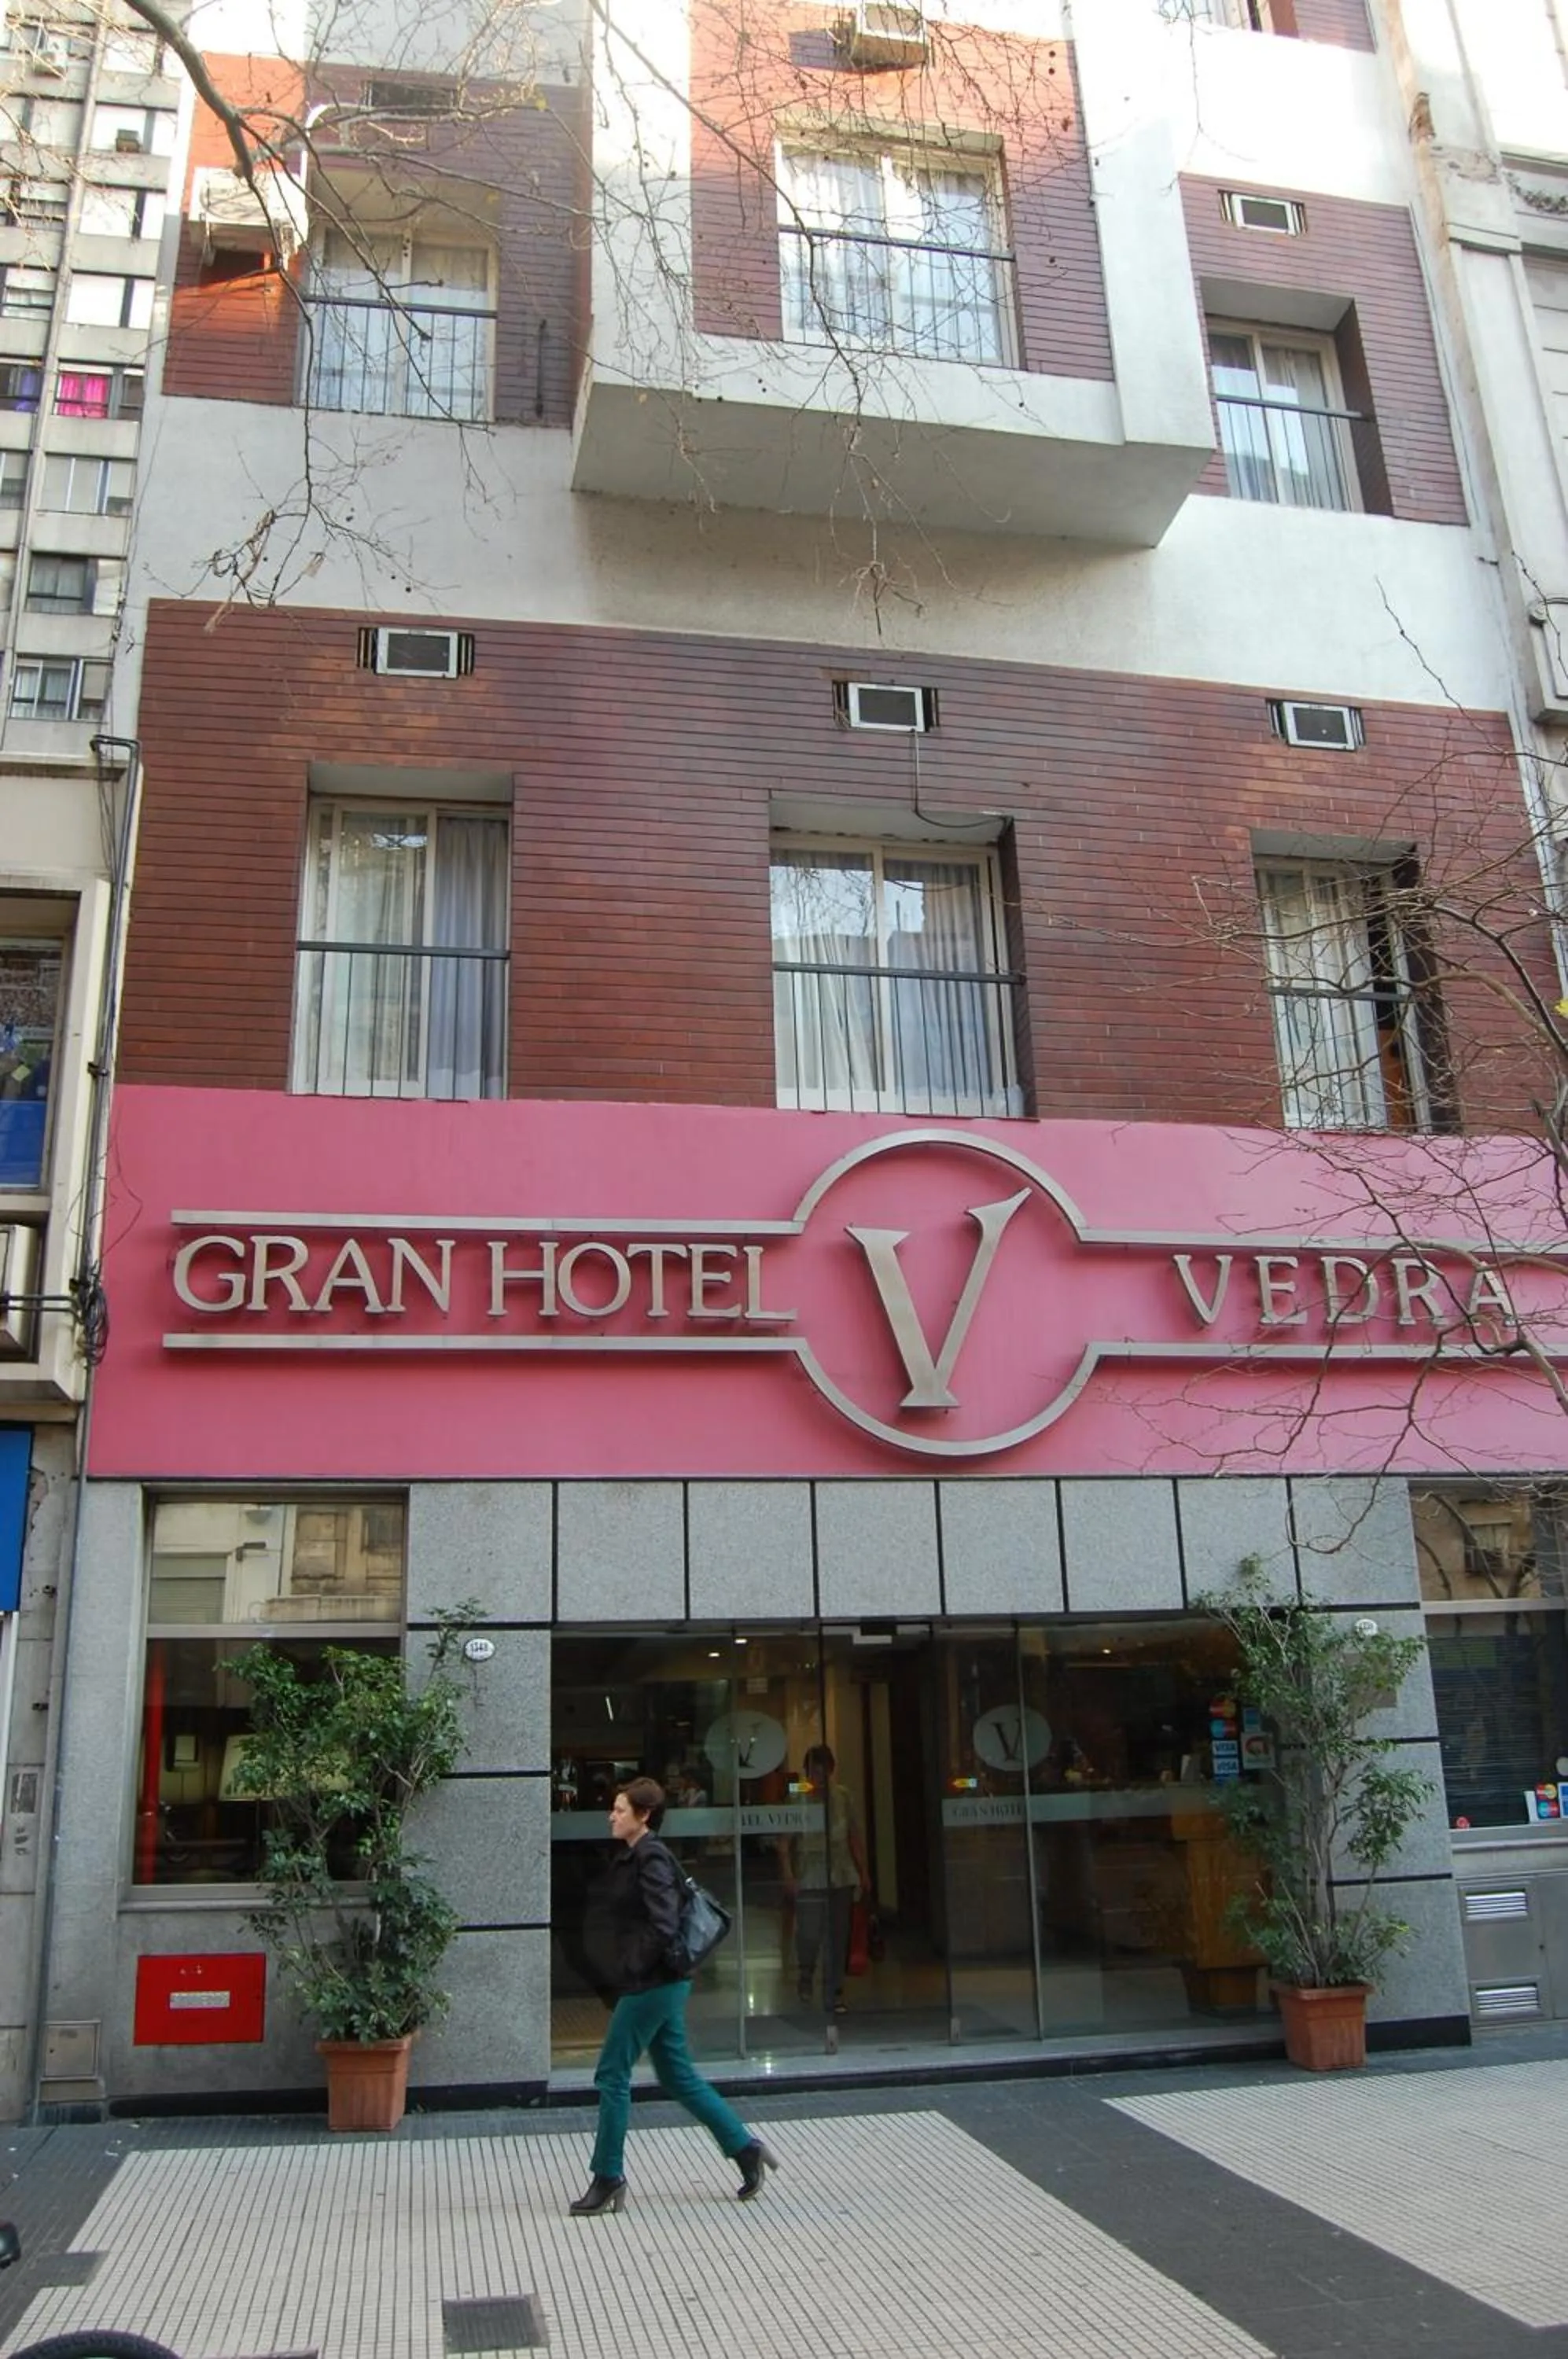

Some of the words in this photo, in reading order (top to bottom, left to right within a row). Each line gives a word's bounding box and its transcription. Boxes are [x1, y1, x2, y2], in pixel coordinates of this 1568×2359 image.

[173, 1235, 455, 1314] GRAN
[487, 1240, 797, 1321] HOTEL
[1173, 1254, 1519, 1327] VEDRA
[845, 1187, 1032, 1408] V
